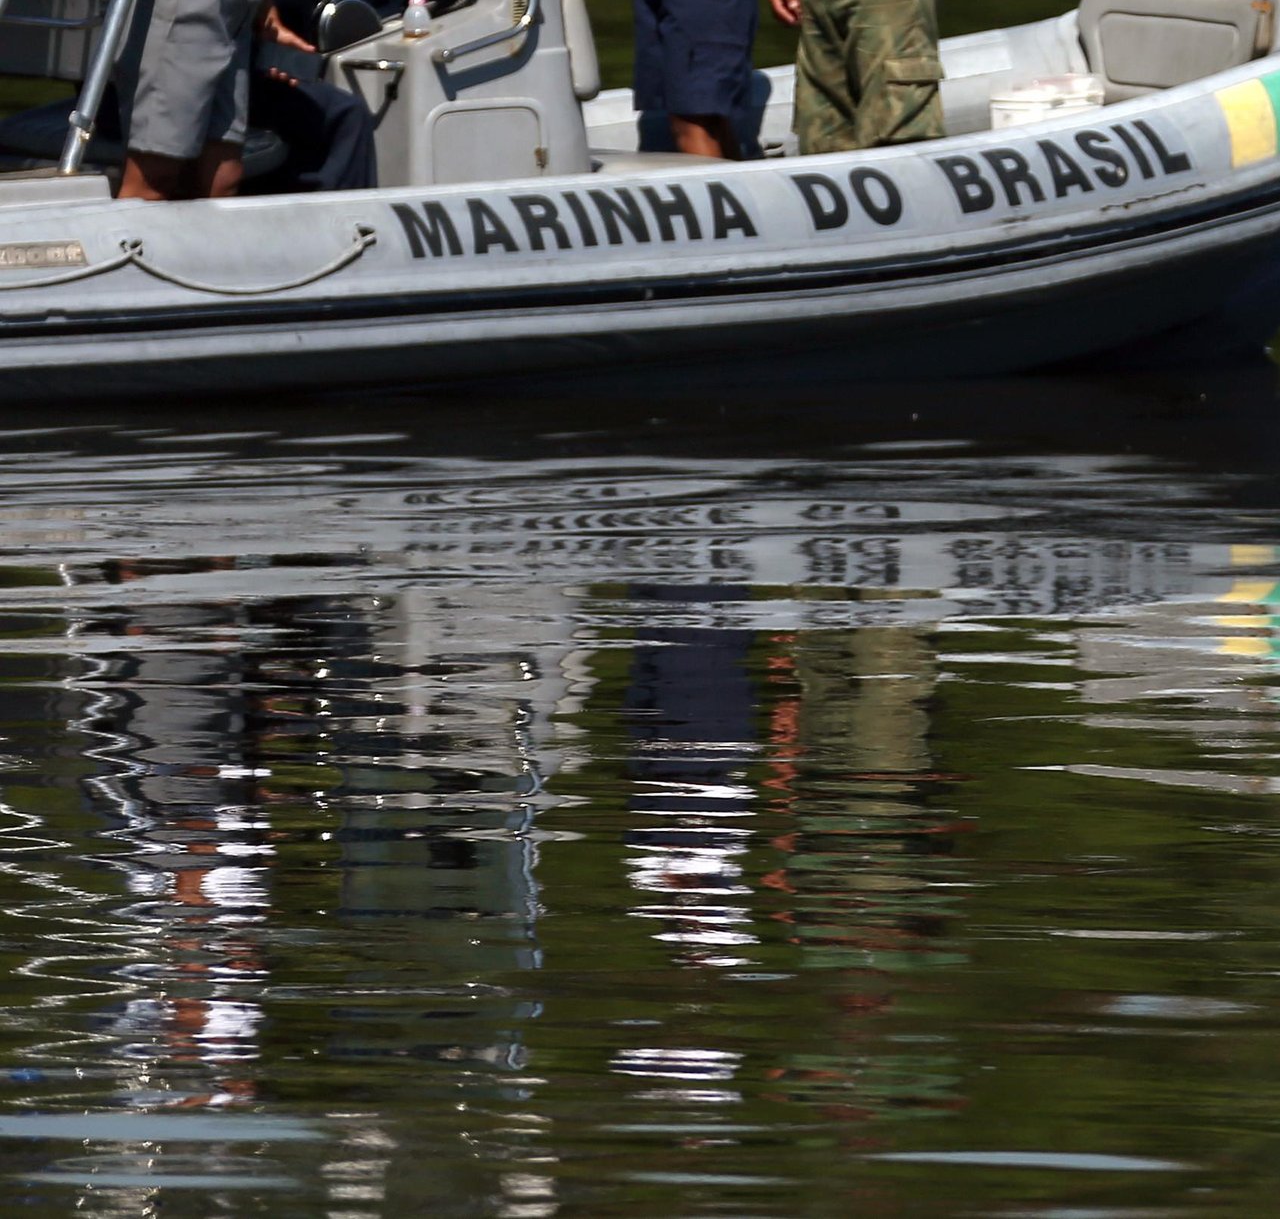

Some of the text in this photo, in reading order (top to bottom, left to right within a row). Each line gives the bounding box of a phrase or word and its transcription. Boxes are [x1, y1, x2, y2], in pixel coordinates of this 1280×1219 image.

[389, 119, 1192, 258] MARINHA DO BRASIL
